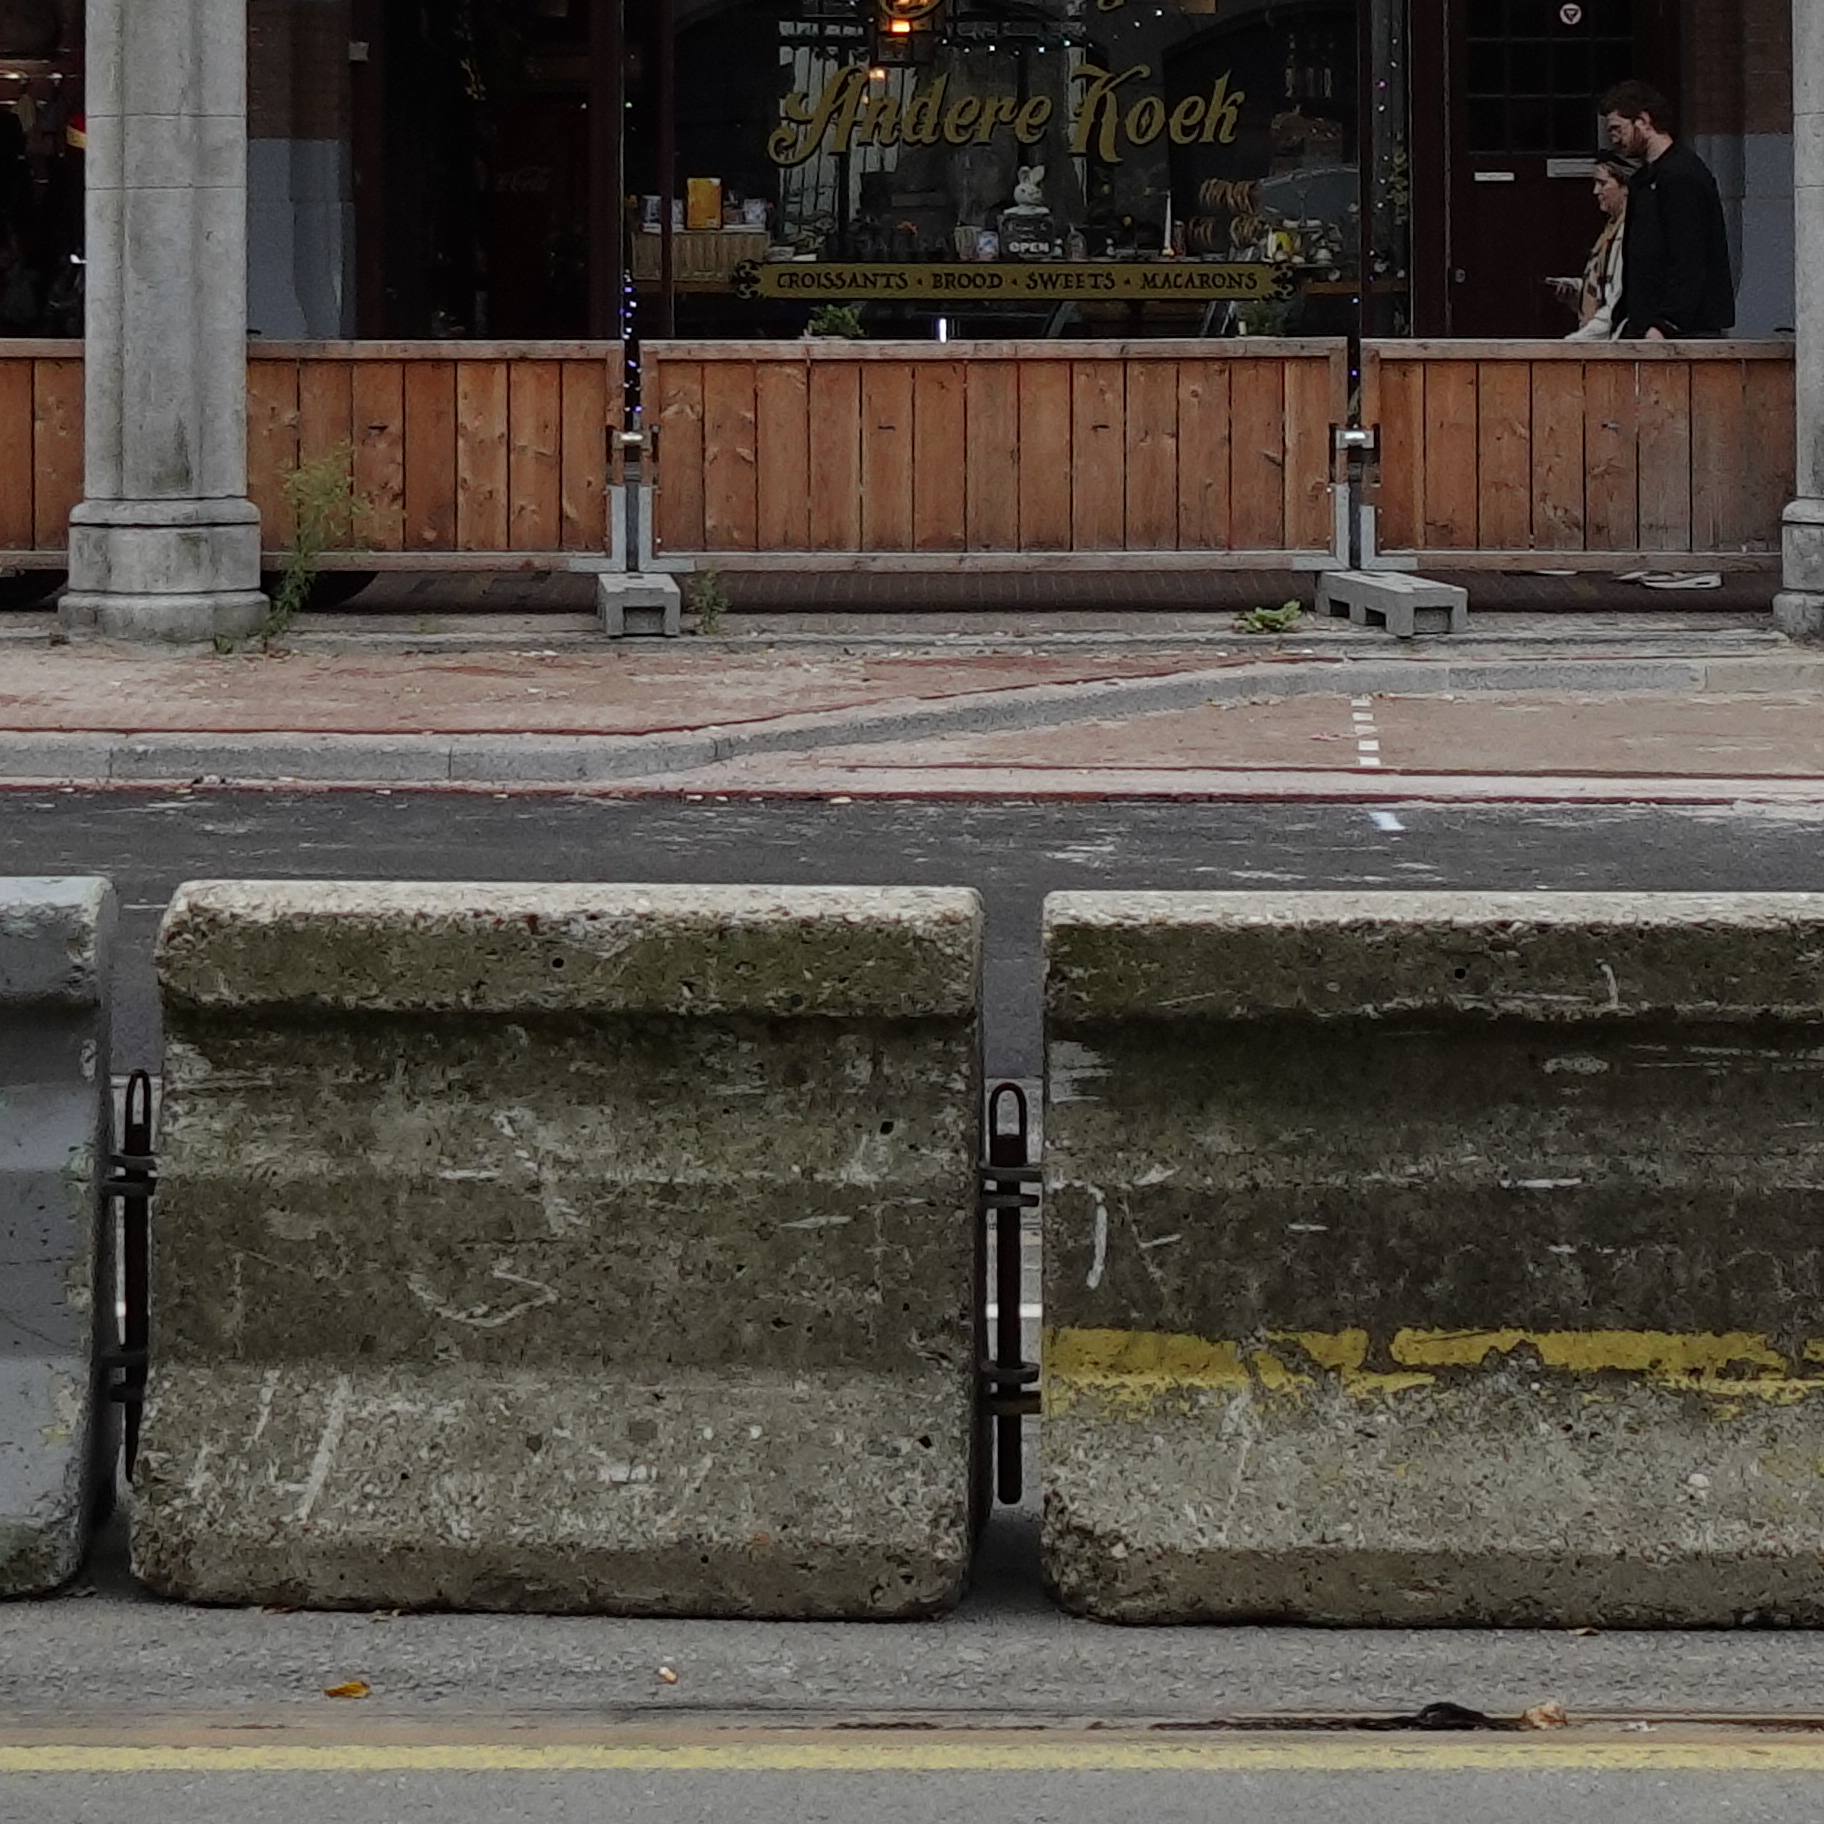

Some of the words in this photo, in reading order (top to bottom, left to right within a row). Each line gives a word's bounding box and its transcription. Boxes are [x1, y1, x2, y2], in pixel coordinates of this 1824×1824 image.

[768, 65, 1053, 166] Andere
[1068, 62, 1246, 163] Koek
[1008, 241, 1050, 253] OPEN
[777, 272, 908, 290] CROISSANTS
[932, 272, 1004, 290] BROOD
[1026, 272, 1115, 290] SWEETS
[1141, 272, 1258, 290] MACARONS
